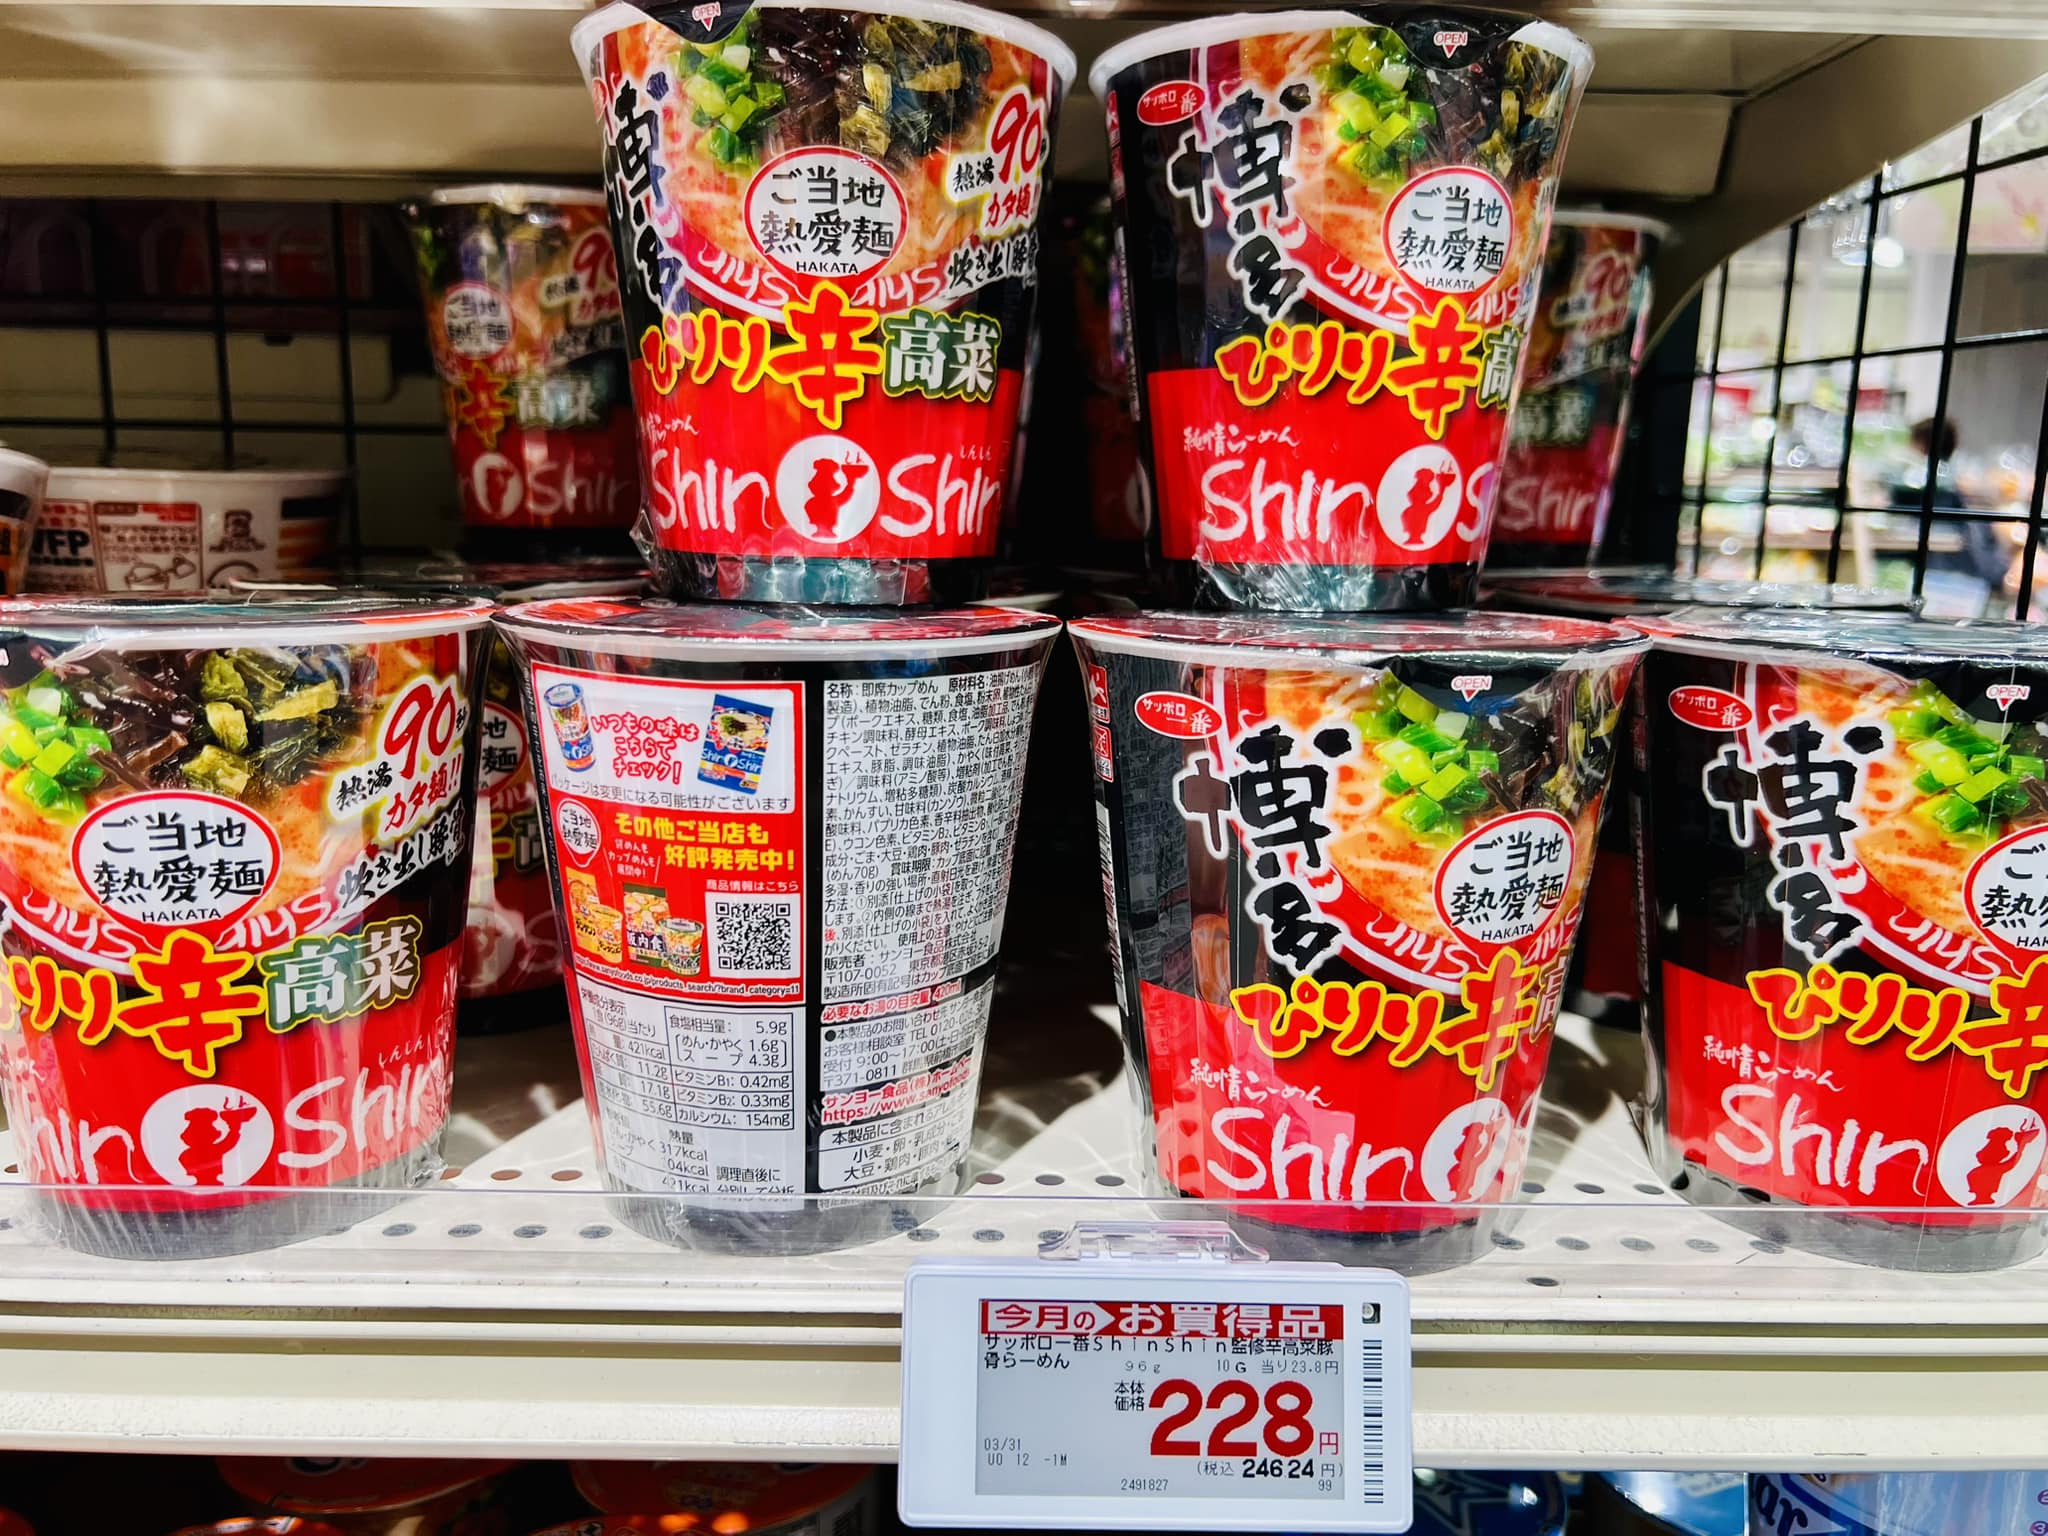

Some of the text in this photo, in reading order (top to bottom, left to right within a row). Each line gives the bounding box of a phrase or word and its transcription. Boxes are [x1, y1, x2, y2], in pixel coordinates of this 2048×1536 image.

[692, 3, 719, 17] OPEN
[1434, 31, 1469, 47] OPEN
[770, 165, 885, 208] ご当地
[1172, 84, 1312, 316] 博多
[1412, 184, 1503, 226] ご当地
[760, 210, 894, 257] 熱愛麺
[1399, 227, 1504, 275] 熱愛麺
[796, 261, 858, 273] HAKATA
[1426, 278, 1475, 289] HAKATA
[1201, 456, 1373, 543] Shin
[34, 530, 90, 555] FP
[1453, 676, 1490, 690] OPEN
[1988, 686, 2029, 699] OPEN
[1142, 698, 1213, 735] サッポロ一番
[1675, 692, 1742, 727] サッポロ一番
[591, 711, 700, 742] いつもの味は
[612, 757, 682, 785] チェック!
[337, 761, 392, 811] 熱湯
[551, 774, 791, 811] パッケージは変更になる可能性がございます
[101, 810, 246, 855] ご当地
[614, 812, 769, 844] その他ご当店も
[1706, 720, 1884, 955] 博多
[664, 844, 795, 871] 好評発売中!
[1178, 726, 1352, 970] 博多
[1470, 833, 1564, 876] ご当地
[93, 856, 265, 906] 熱愛麺
[826, 867, 880, 881] (めん70g)
[707, 879, 799, 892] 商品情報はこちら
[1450, 873, 1565, 926] 熱愛麺
[142, 908, 221, 922] HAKATA
[1481, 923, 1534, 940] HAKATA
[756, 1021, 787, 1035] 5.9g
[910, 1027, 928, 1041] TEL
[628, 1041, 666, 1061] 421kcal
[749, 1039, 780, 1052] 1.6g
[749, 1054, 780, 1068] 4.3g
[638, 1061, 667, 1081] 11.2g
[641, 1081, 670, 1099] 17.1g
[740, 1075, 790, 1089] 0.42mg
[741, 1094, 791, 1108] 0.33mg
[746, 1113, 791, 1127] 154mg
[669, 1129, 694, 1146] 熱量
[1714, 1083, 1929, 1197] Shin
[659, 1140, 709, 1162] 317kcal
[1206, 1106, 1414, 1208] Shin
[717, 1166, 781, 1182] 調理直後に
[984, 1352, 1070, 1370] 骨らーめん
[1114, 1380, 1145, 1395] 本体
[1114, 1396, 1145, 1411] 価格
[1148, 1378, 1339, 1457] 228 円
[984, 1438, 1022, 1451] 03/31
[1016, 1454, 1029, 1467] 12
[1043, 1454, 1068, 1467] -1M
[1121, 1479, 1169, 1492] 2491827
[1318, 1480, 1332, 1492] 99
